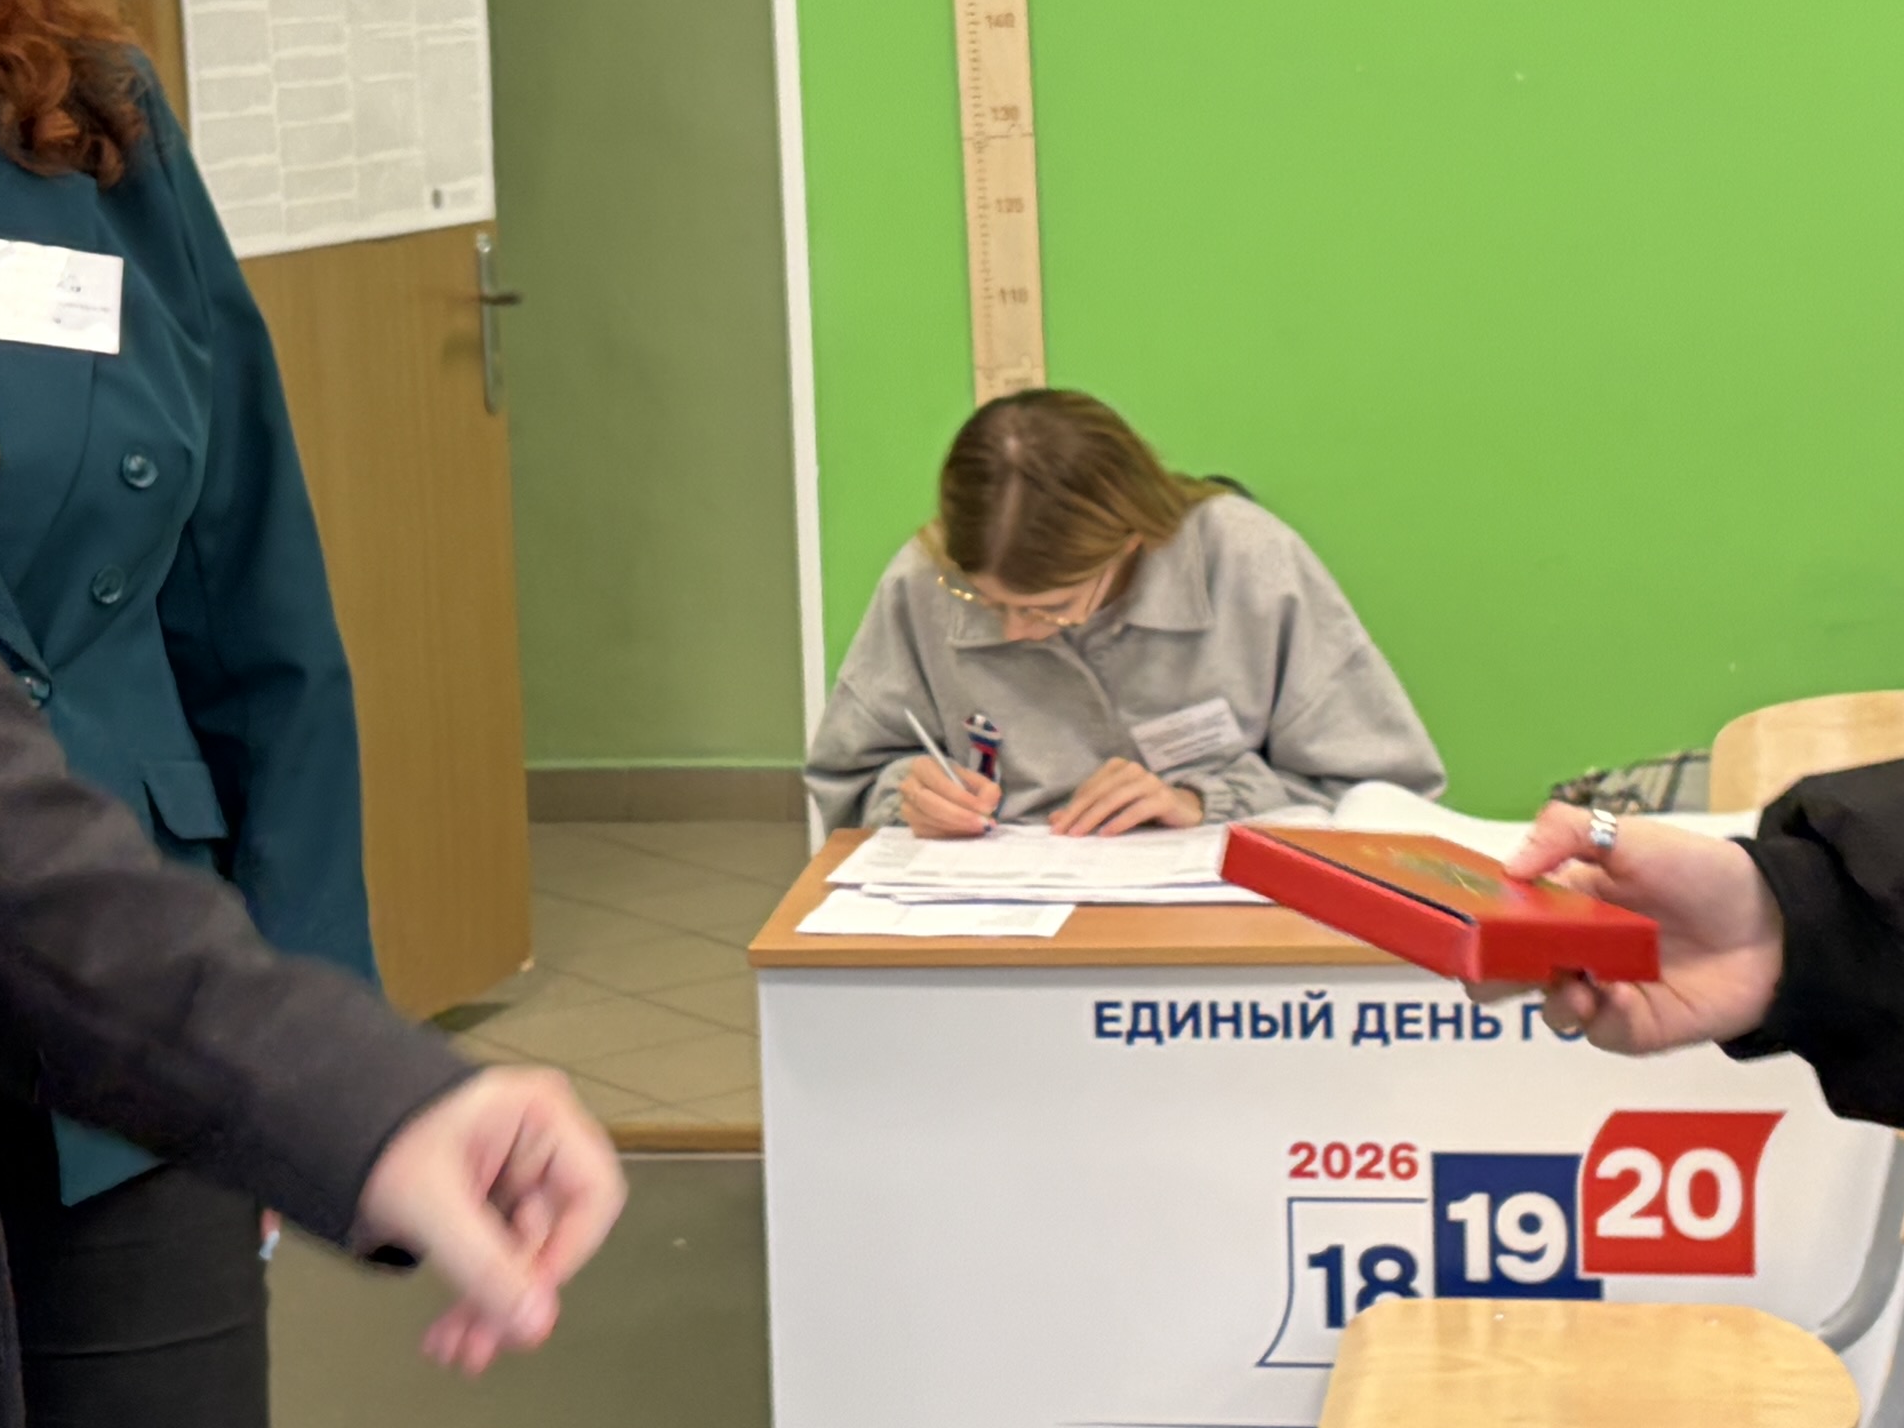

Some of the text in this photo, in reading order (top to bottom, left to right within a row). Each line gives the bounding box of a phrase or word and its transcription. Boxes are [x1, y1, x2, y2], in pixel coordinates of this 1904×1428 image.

[1094, 990, 1335, 1046] ЕДИНЫЙ
[1352, 1002, 1503, 1047] ДЕНЬ
[1288, 1141, 1419, 1181] 2026
[1307, 1147, 1743, 1329] 18 19 20
